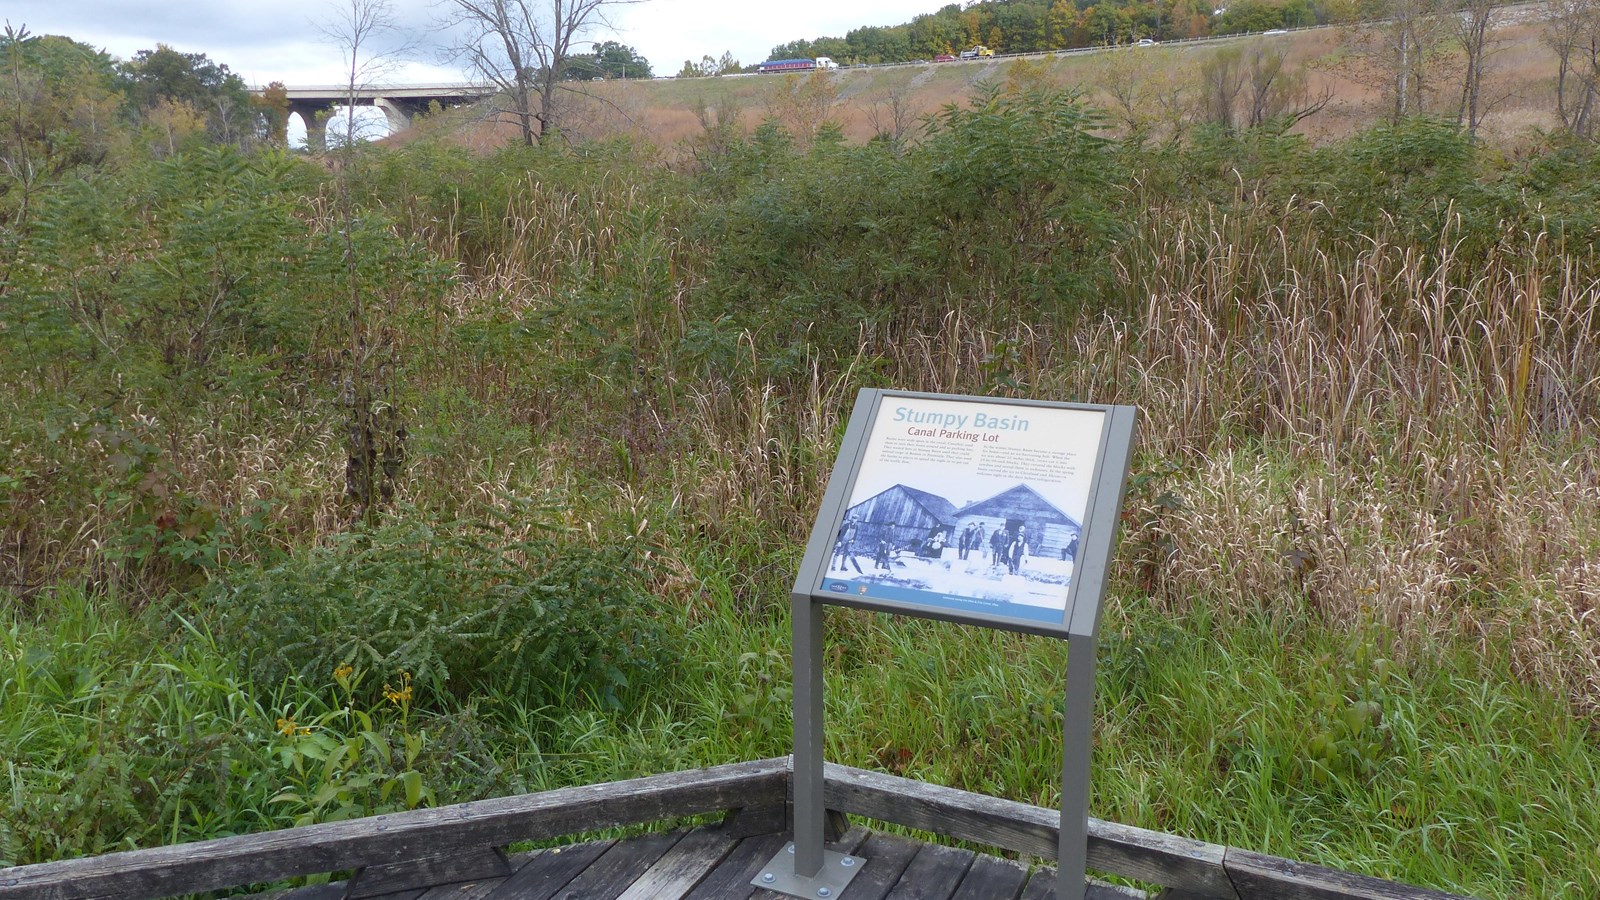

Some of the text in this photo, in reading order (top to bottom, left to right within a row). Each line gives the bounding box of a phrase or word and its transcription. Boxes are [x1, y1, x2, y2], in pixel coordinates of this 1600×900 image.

[893, 406, 1030, 432] Stumpy Basin
[907, 426, 937, 437] Canal
[939, 429, 979, 443] Parking
[982, 432, 1000, 443] Lot
